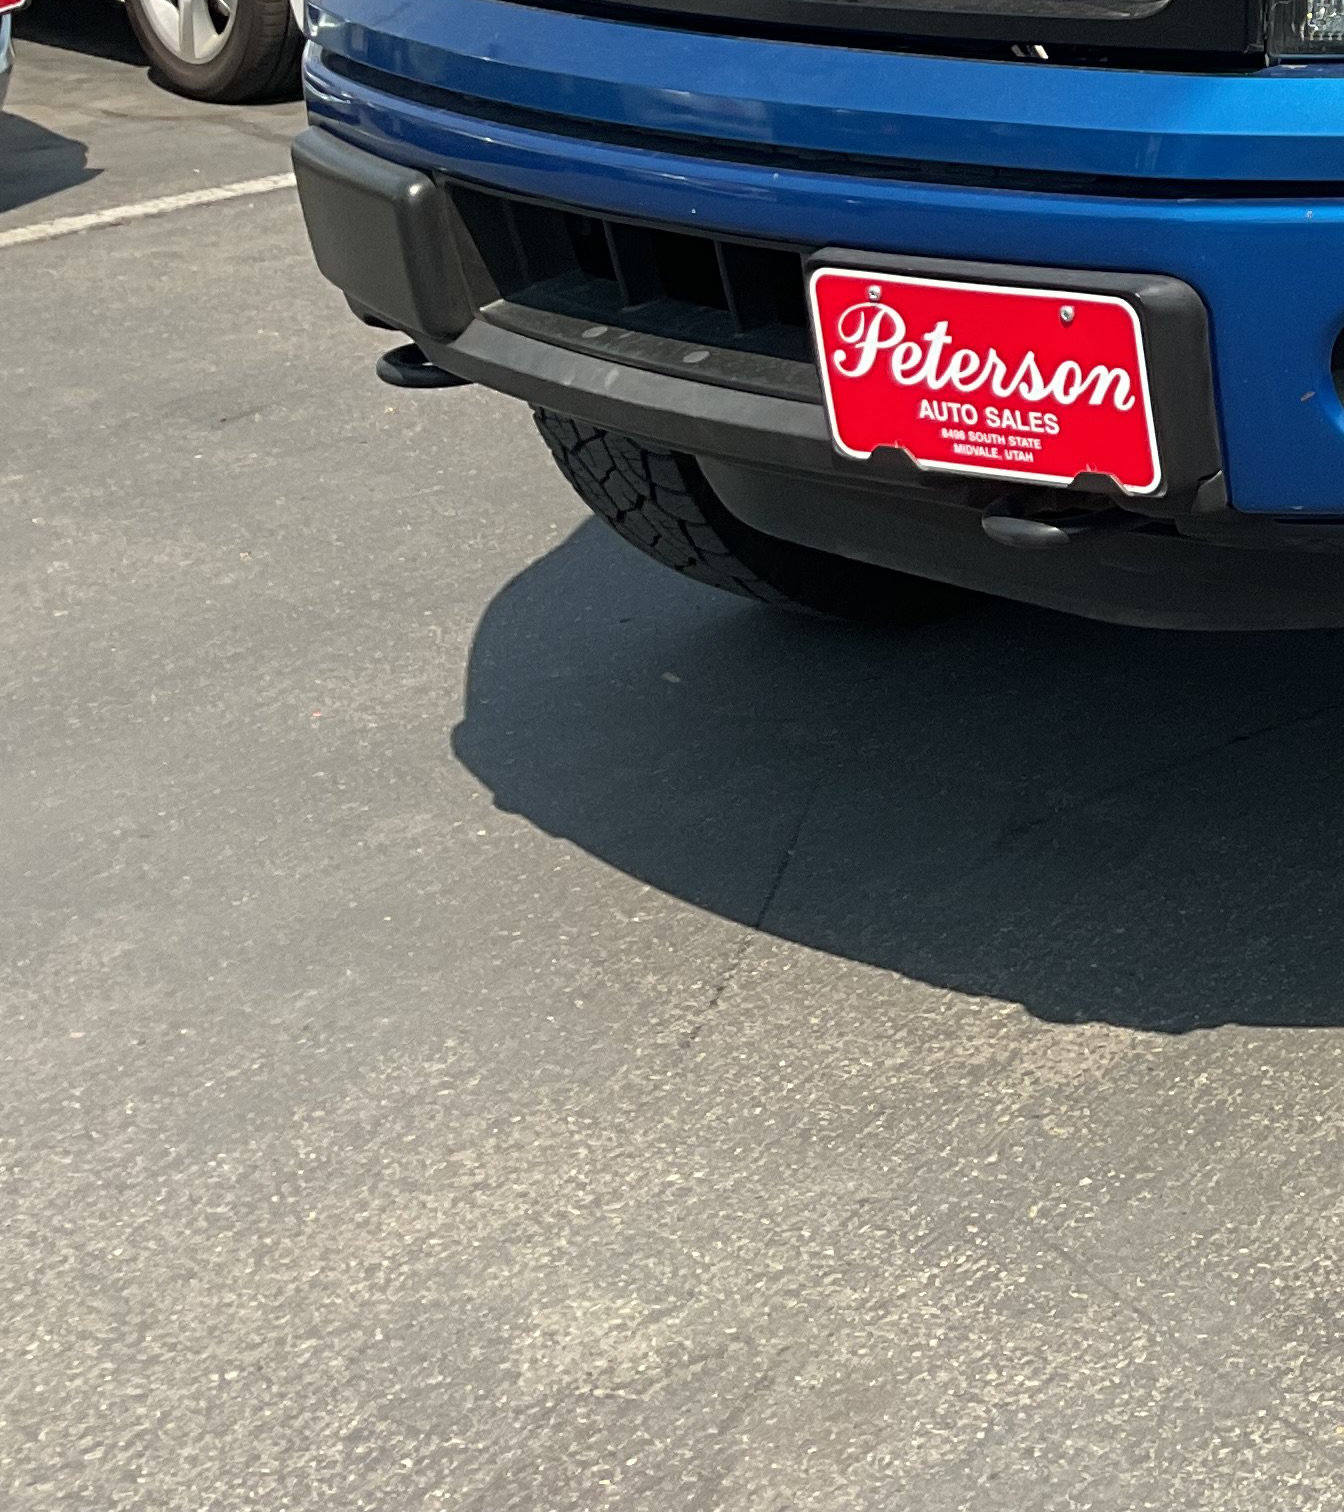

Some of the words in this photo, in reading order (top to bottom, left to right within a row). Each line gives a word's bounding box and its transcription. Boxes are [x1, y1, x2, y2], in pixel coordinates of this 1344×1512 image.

[833, 302, 1135, 411] Peterson
[919, 399, 978, 425] AUTO
[984, 406, 1059, 435] SALES
[968, 431, 1006, 445] SOUTH
[1008, 436, 1042, 449] STATE
[1004, 449, 1034, 462] UTAH
